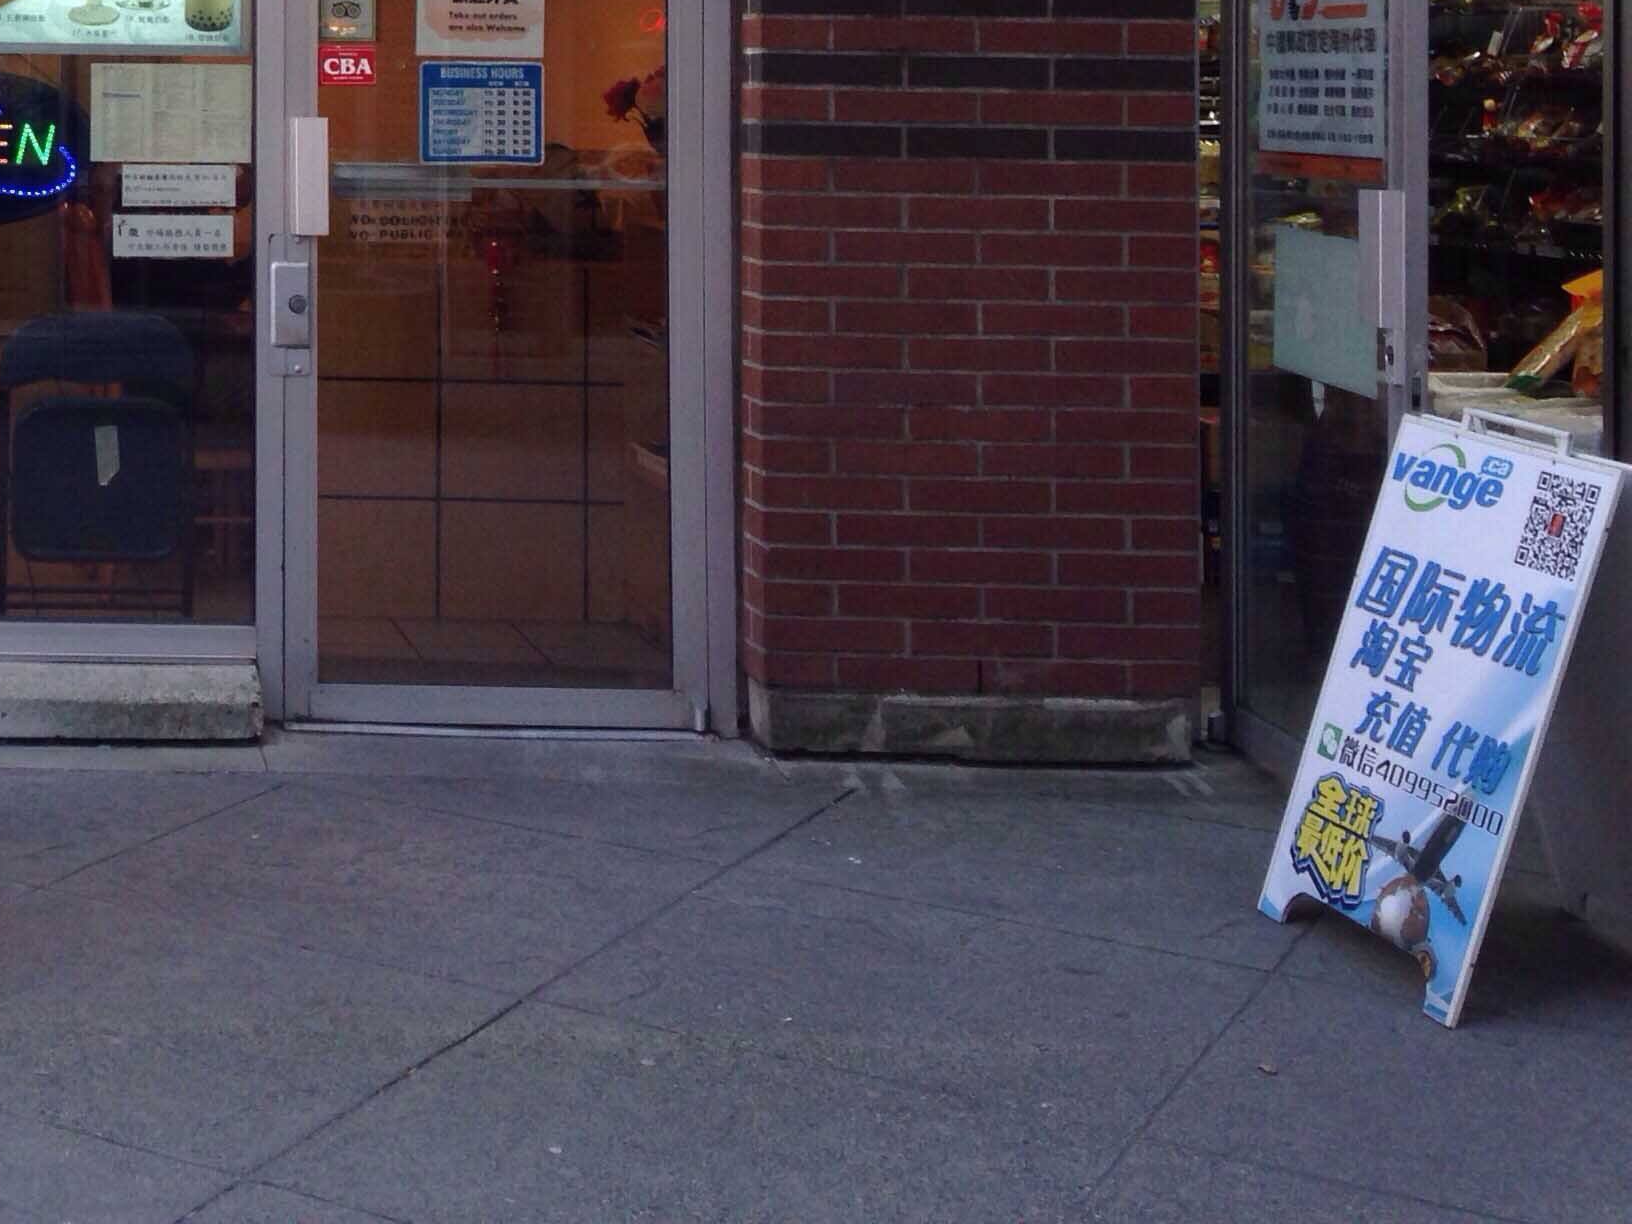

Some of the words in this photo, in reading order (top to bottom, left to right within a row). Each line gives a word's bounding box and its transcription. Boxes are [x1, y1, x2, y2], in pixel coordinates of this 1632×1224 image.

[323, 57, 373, 76] CBA
[440, 66, 488, 79] BUSINESS
[490, 67, 525, 79] HOURS
[1355, 545, 1566, 677] 国际物流
[1350, 618, 1434, 694] 淘宝
[1353, 690, 1433, 758] 充值
[1430, 720, 1512, 797] 代购
[1306, 776, 1378, 838] 全球
[1295, 810, 1371, 898] 最低价
